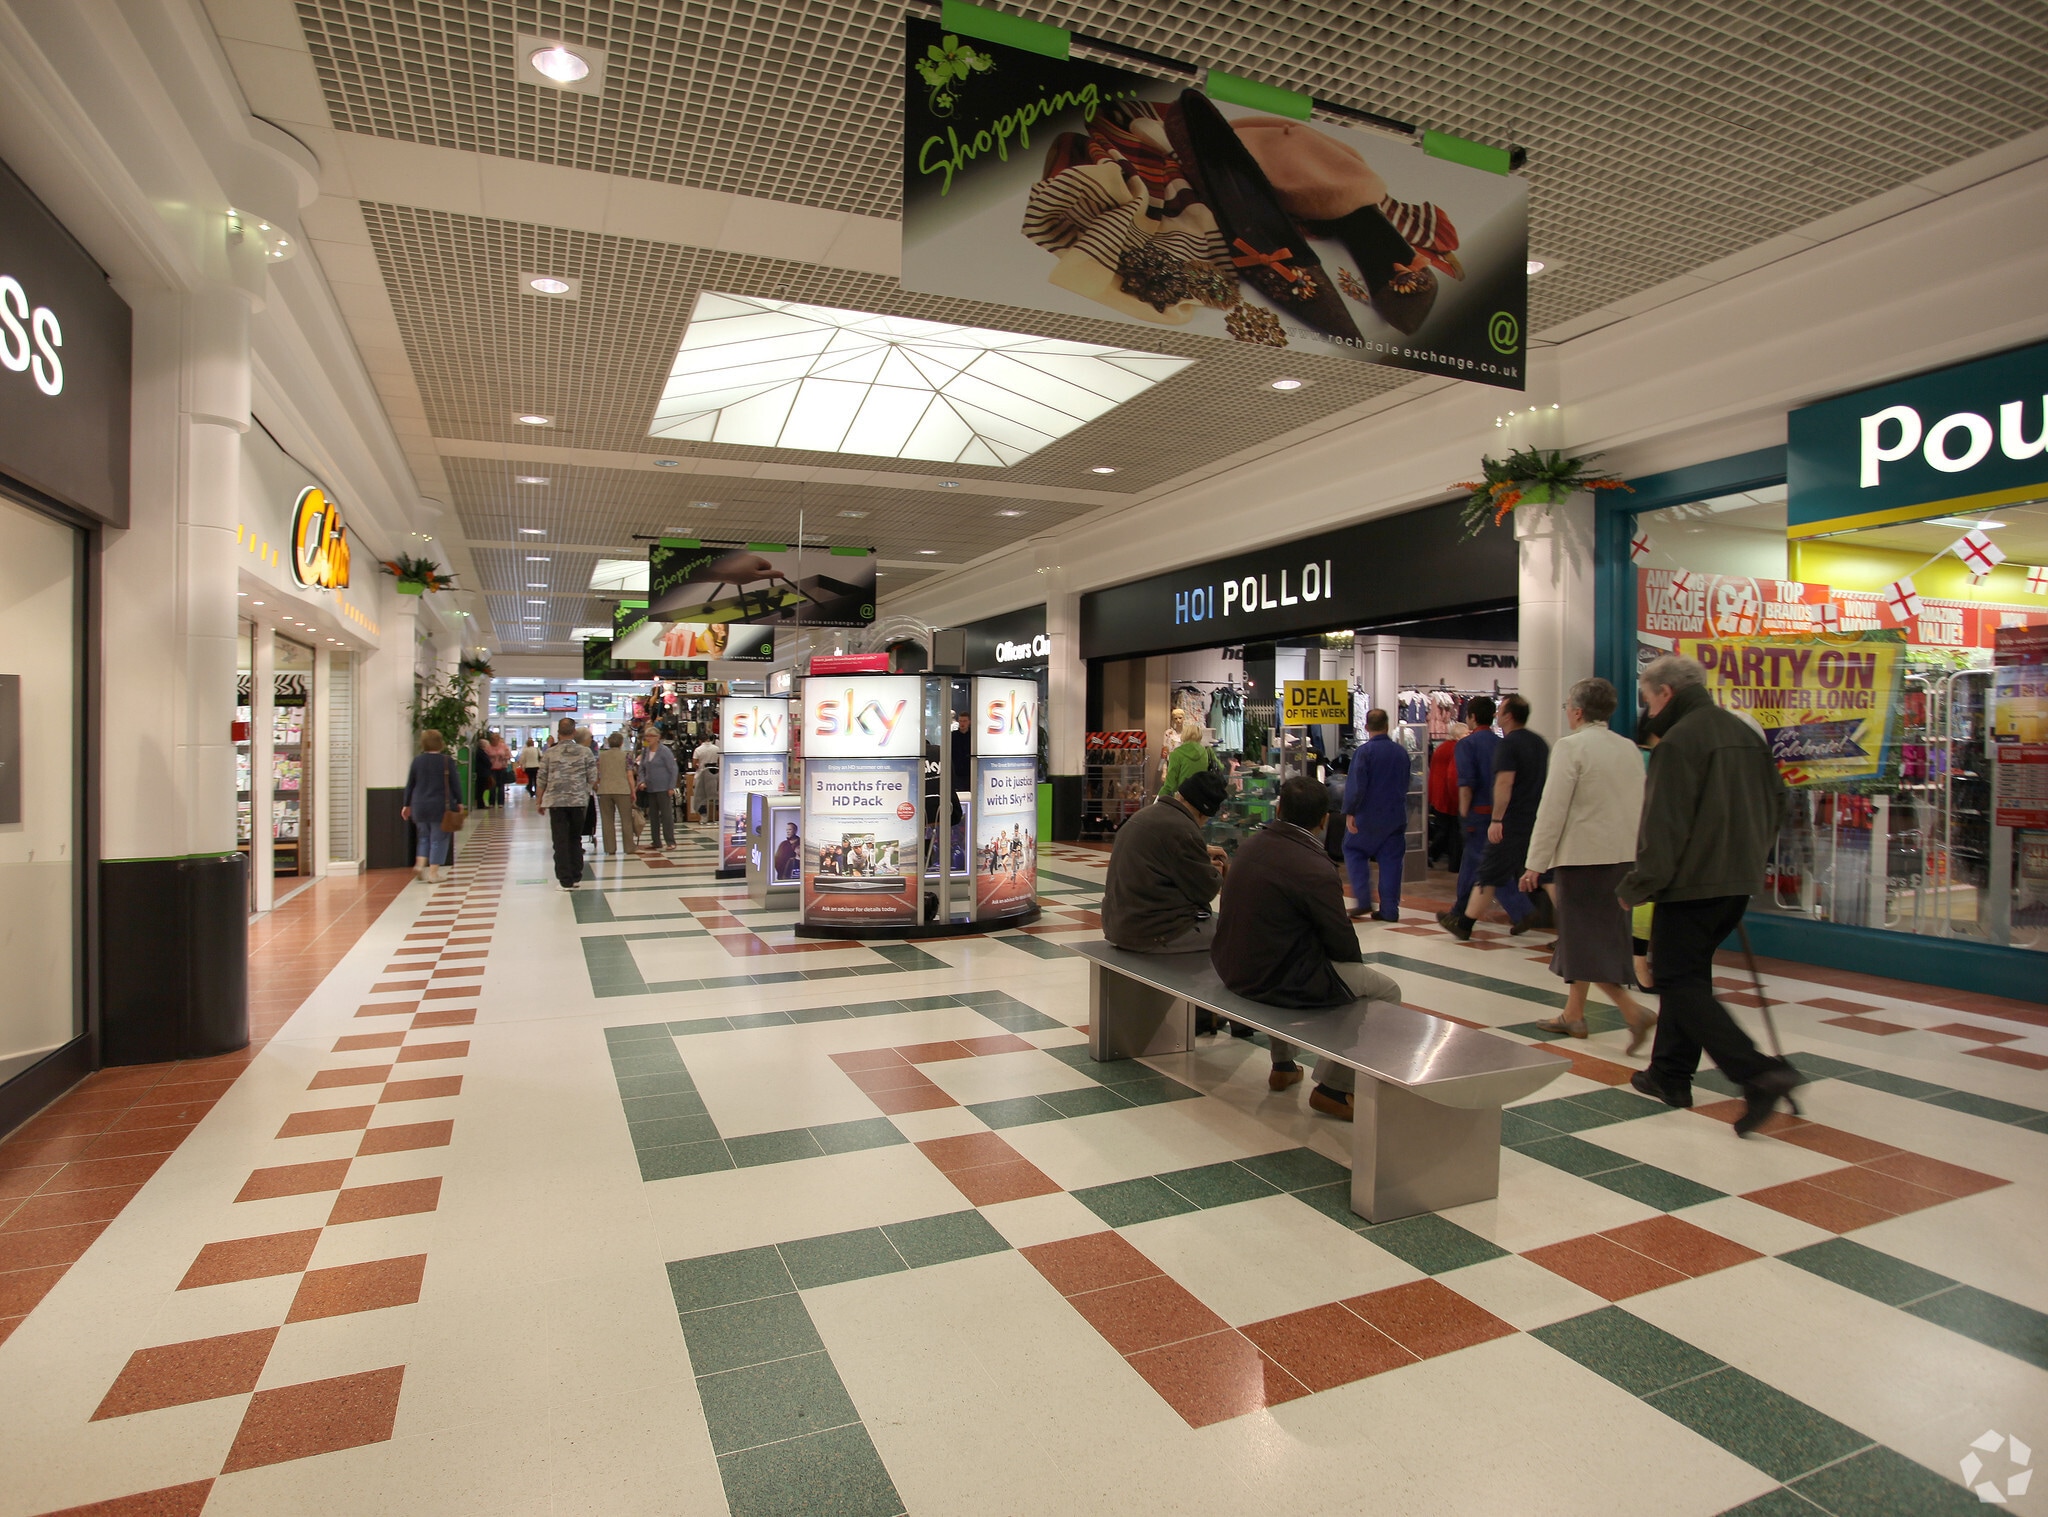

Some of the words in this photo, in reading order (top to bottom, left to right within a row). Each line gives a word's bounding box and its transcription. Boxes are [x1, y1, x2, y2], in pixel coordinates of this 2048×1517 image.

[1489, 311, 1518, 354] @
[1175, 586, 1213, 624] HOI
[1223, 559, 1331, 616] POLLOI
[1775, 580, 1805, 604] TOP
[860, 604, 875, 619] @
[1646, 588, 1705, 617] VALUE
[1716, 584, 1759, 635] £1
[1765, 602, 1813, 622] BRANDS
[1844, 600, 1877, 619] WOW!
[1646, 613, 1705, 633] EVERYDAY
[1918, 606, 1963, 624] AMAZING
[1918, 621, 1964, 646] VALUE!
[996, 641, 1031, 663] Officers
[1032, 633, 1051, 657] Clu
[1696, 644, 1814, 687] PARTY
[1818, 650, 1876, 689] ON
[1292, 688, 1341, 706] DEAL
[1730, 688, 1812, 709] SUMMER
[1816, 690, 1876, 710] LONG!
[816, 688, 907, 746] sky
[987, 690, 1036, 745] sky
[1286, 709, 1298, 719] OF
[1301, 708, 1318, 718] THE
[1321, 708, 1346, 718] WEEK
[732, 705, 783, 744] sky
[733, 769, 739, 777] 3
[740, 768, 768, 777] months
[769, 767, 781, 776] free
[745, 779, 757, 787] HD
[758, 778, 773, 787] Pack
[991, 777, 1004, 788] Do
[1005, 775, 1012, 787] it
[1012, 775, 1033, 790] justice
[816, 781, 823, 791] 3
[825, 780, 873, 791] months
[875, 780, 902, 791] free
[832, 796, 850, 806] HD
[853, 795, 883, 806] Pack
[987, 795, 1008, 806] with
[1026, 792, 1034, 803] HD
[752, 843, 761, 872] sky
